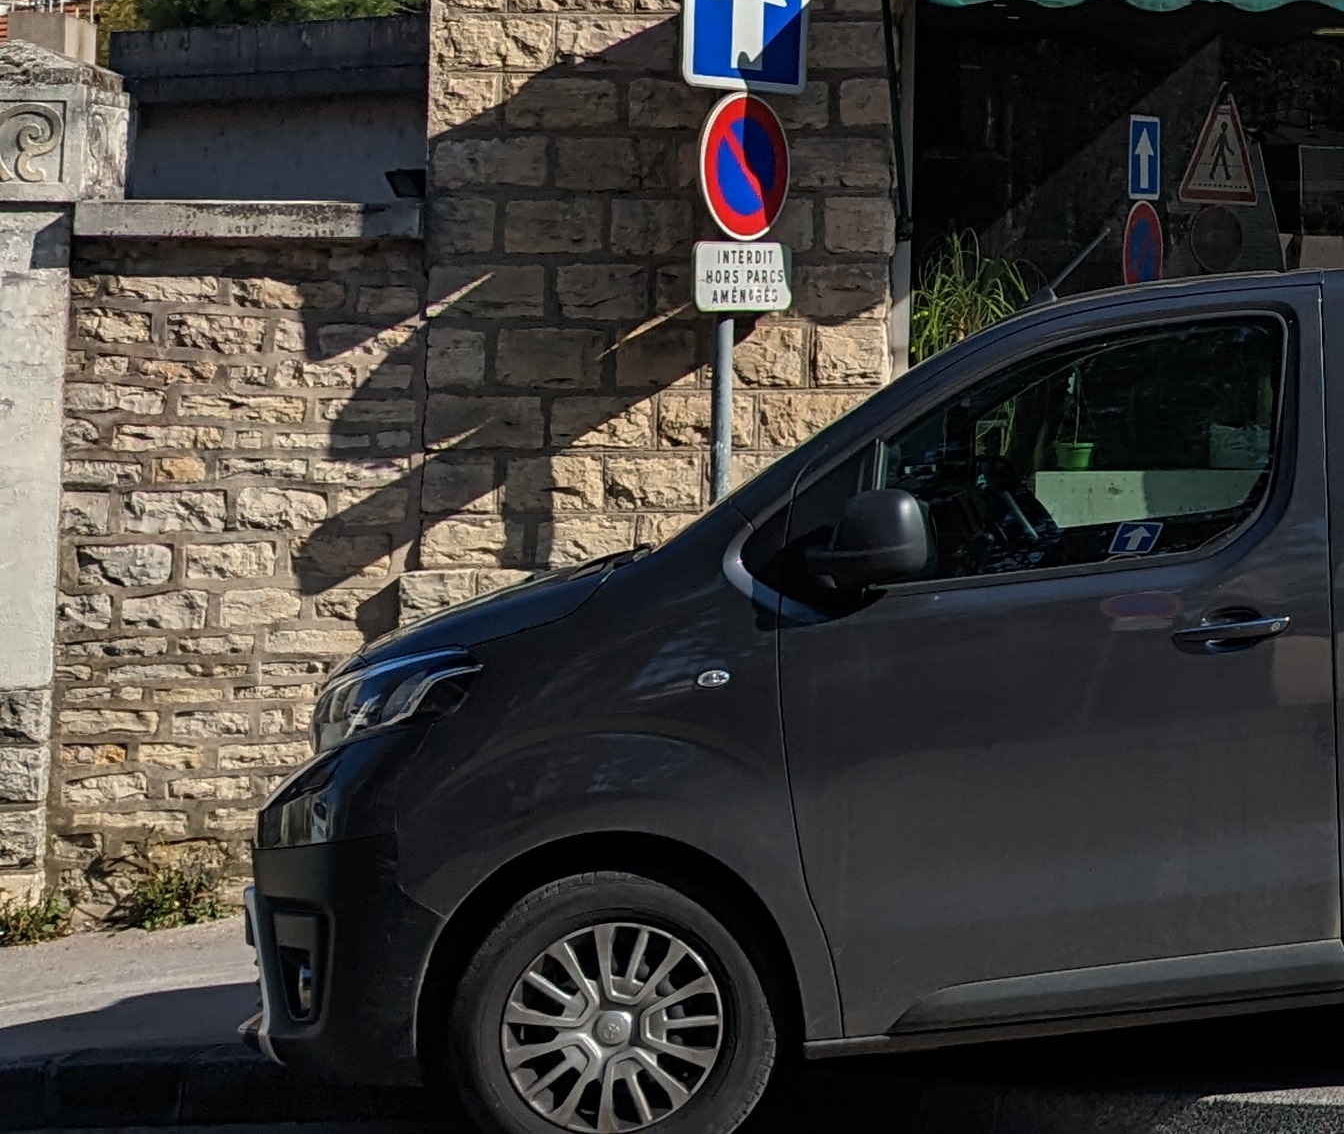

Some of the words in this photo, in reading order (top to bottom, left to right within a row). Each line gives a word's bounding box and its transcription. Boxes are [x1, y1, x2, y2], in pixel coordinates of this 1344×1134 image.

[717, 250, 774, 264] INTERDIT
[706, 269, 739, 284] HORS
[746, 270, 784, 284] PARCS
